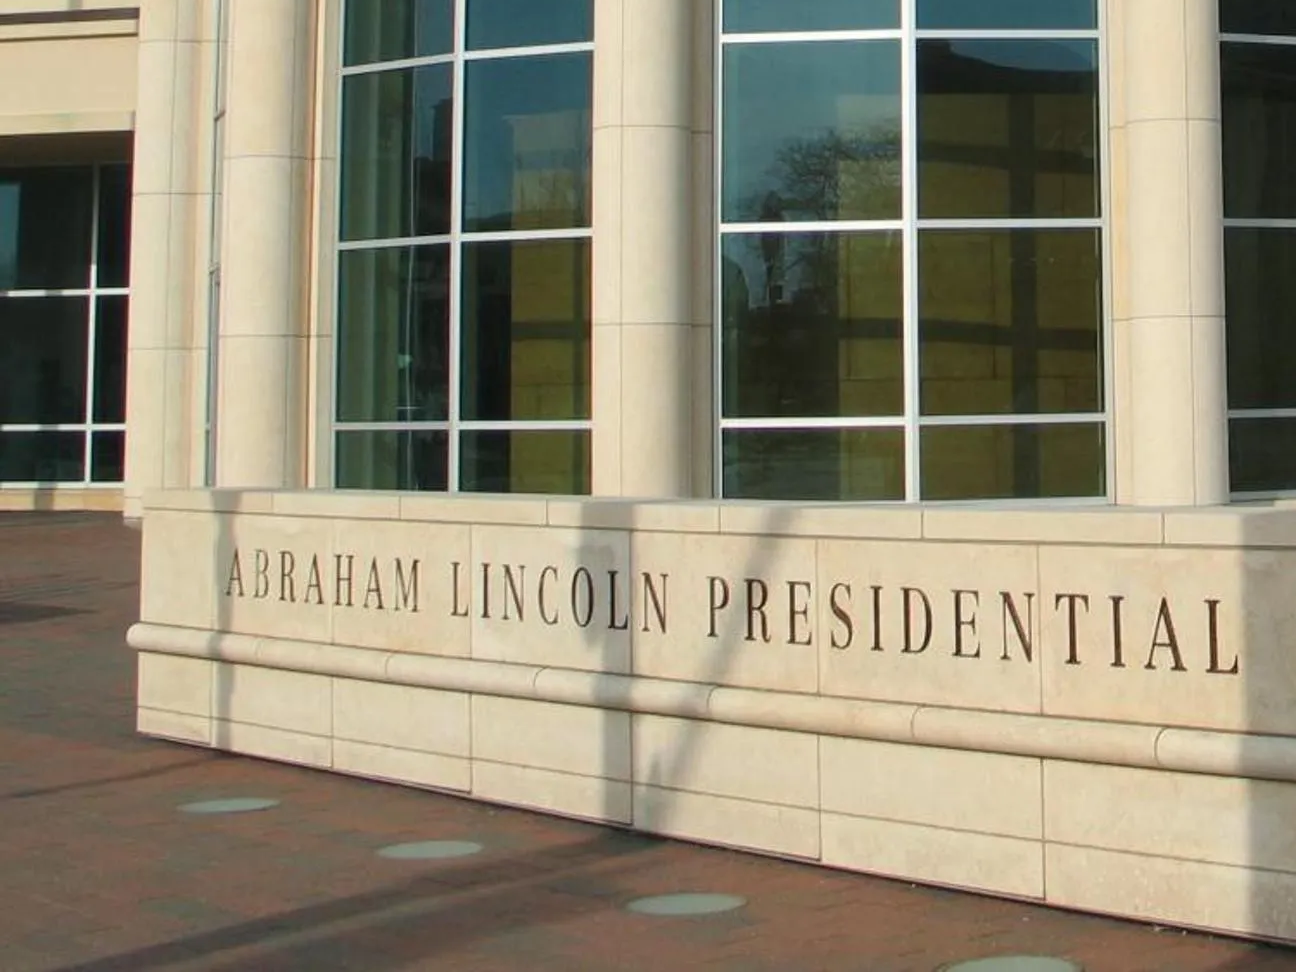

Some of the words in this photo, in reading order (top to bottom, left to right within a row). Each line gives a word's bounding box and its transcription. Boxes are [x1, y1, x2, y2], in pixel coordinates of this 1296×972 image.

[225, 546, 421, 613] ABRAHAM
[450, 561, 669, 634] LINCOLN
[706, 575, 1240, 675] PRESIDENTIAL
